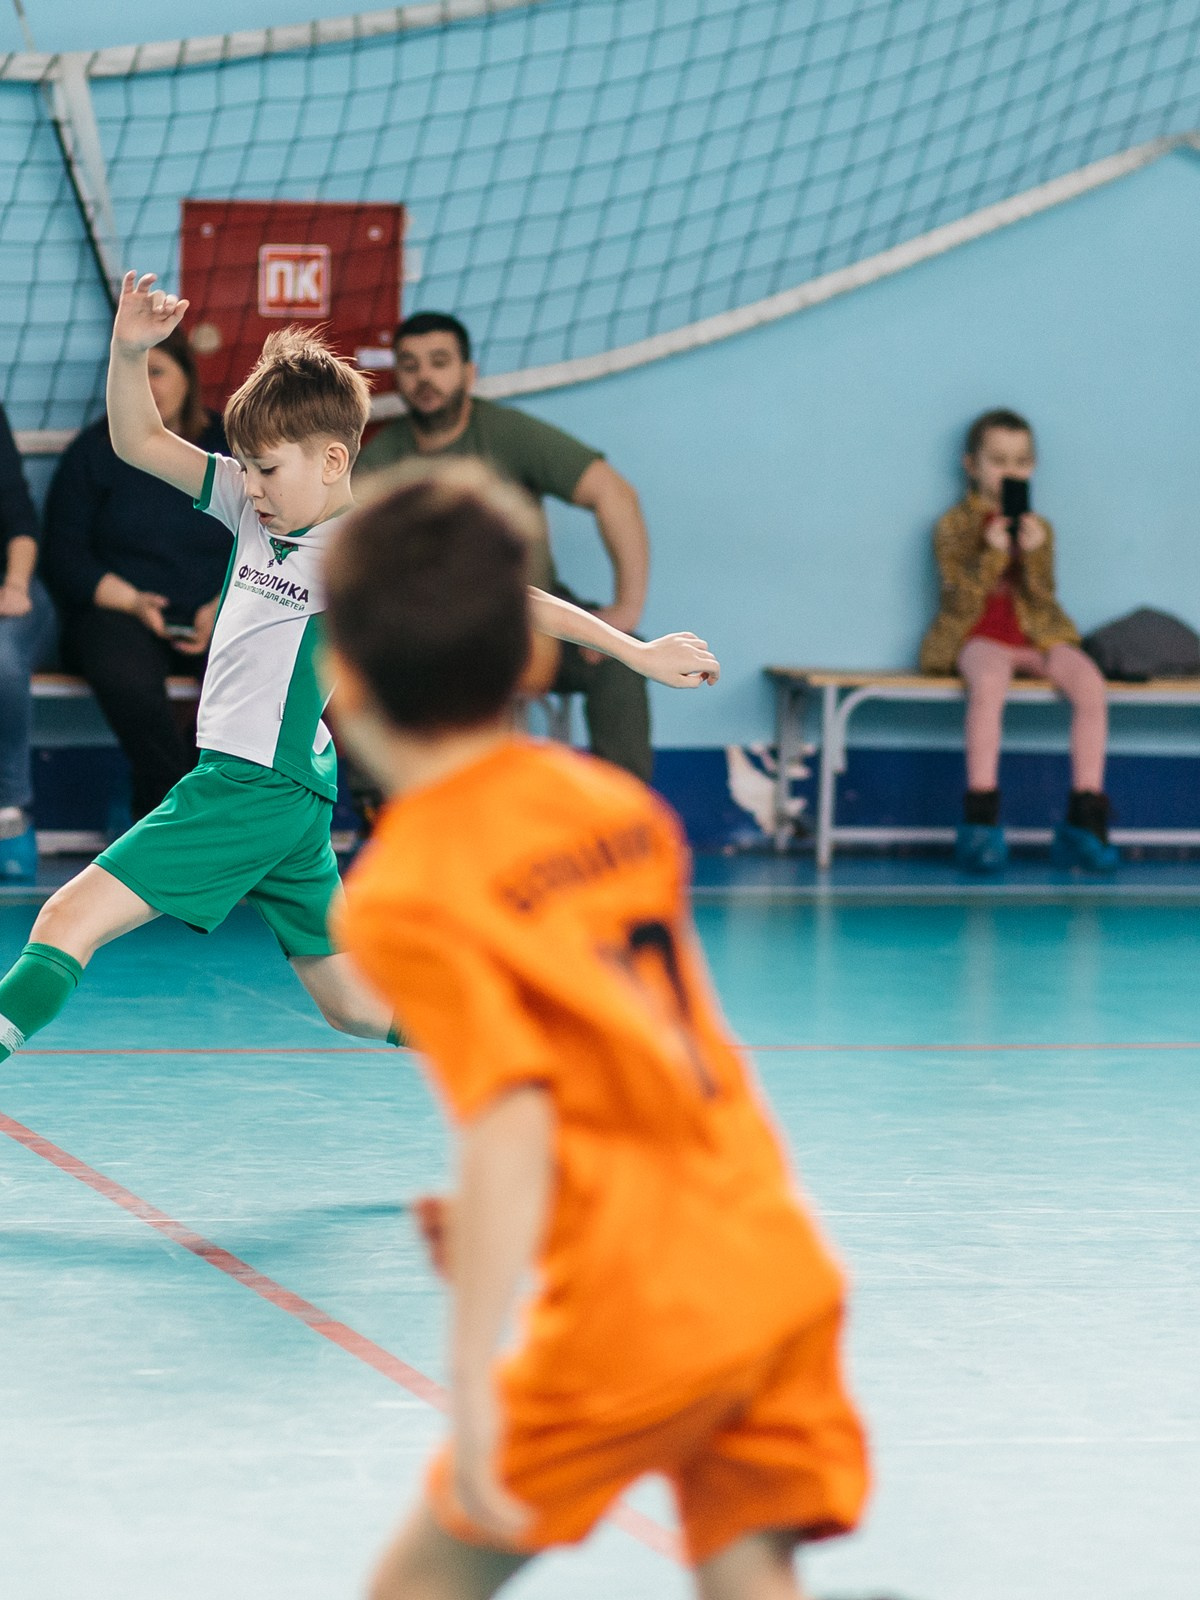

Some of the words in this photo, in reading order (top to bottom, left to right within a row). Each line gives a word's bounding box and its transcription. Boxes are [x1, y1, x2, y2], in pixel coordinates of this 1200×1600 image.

[267, 260, 320, 301] ПК
[264, 591, 279, 602] ДЛЯ
[279, 599, 305, 612] ДЕТЕЙ
